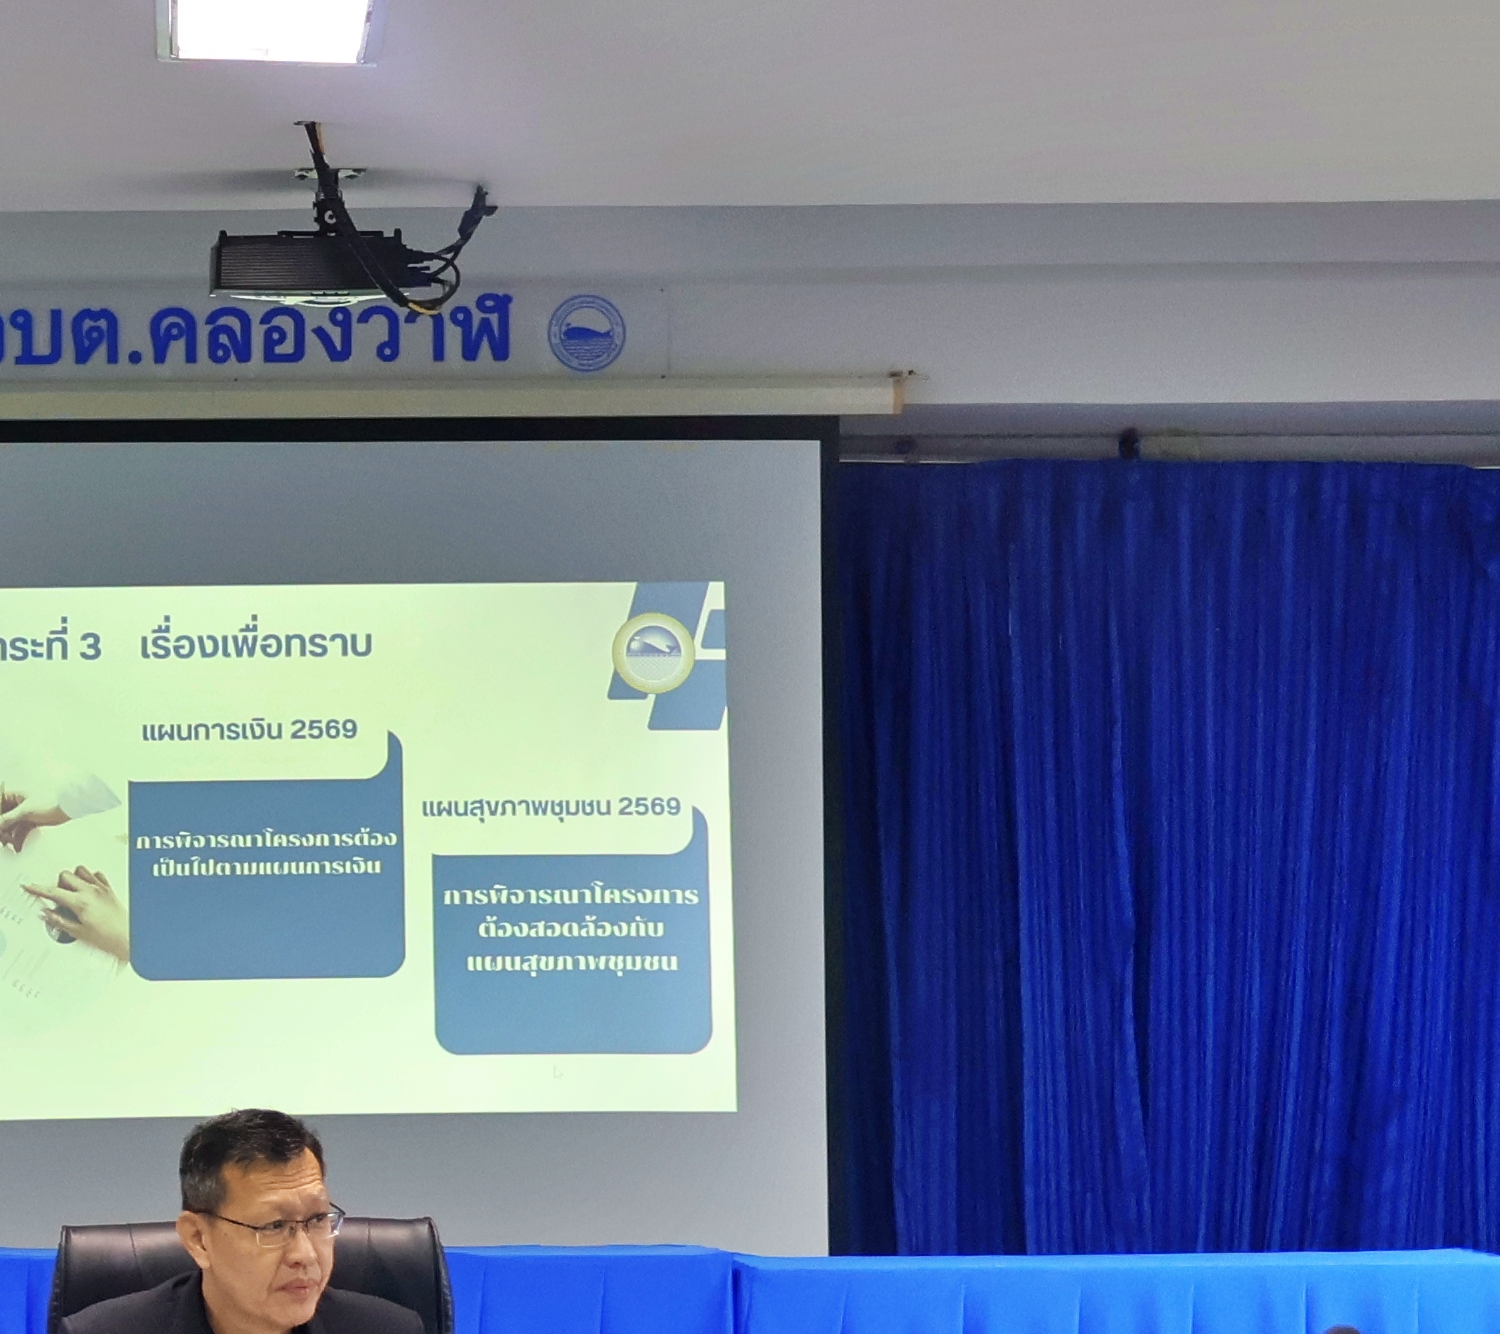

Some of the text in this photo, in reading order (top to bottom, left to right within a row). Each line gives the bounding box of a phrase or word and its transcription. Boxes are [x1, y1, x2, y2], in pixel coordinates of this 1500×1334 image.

[79, 631, 101, 660] 3
[140, 614, 373, 659] เรื่องเพื่อทราบ
[142, 717, 358, 741] แผนการเงิน 2569
[422, 796, 681, 823] แผนสุขภาพชุมชน 2569
[136, 827, 397, 849] การพิจารณาโครงการต้อง
[152, 856, 381, 877] เป็นไปตามแผนการเงิน
[443, 880, 699, 905] การพิจารณาโครงการ
[466, 953, 679, 977] แผนสุขภาพชุมชน
